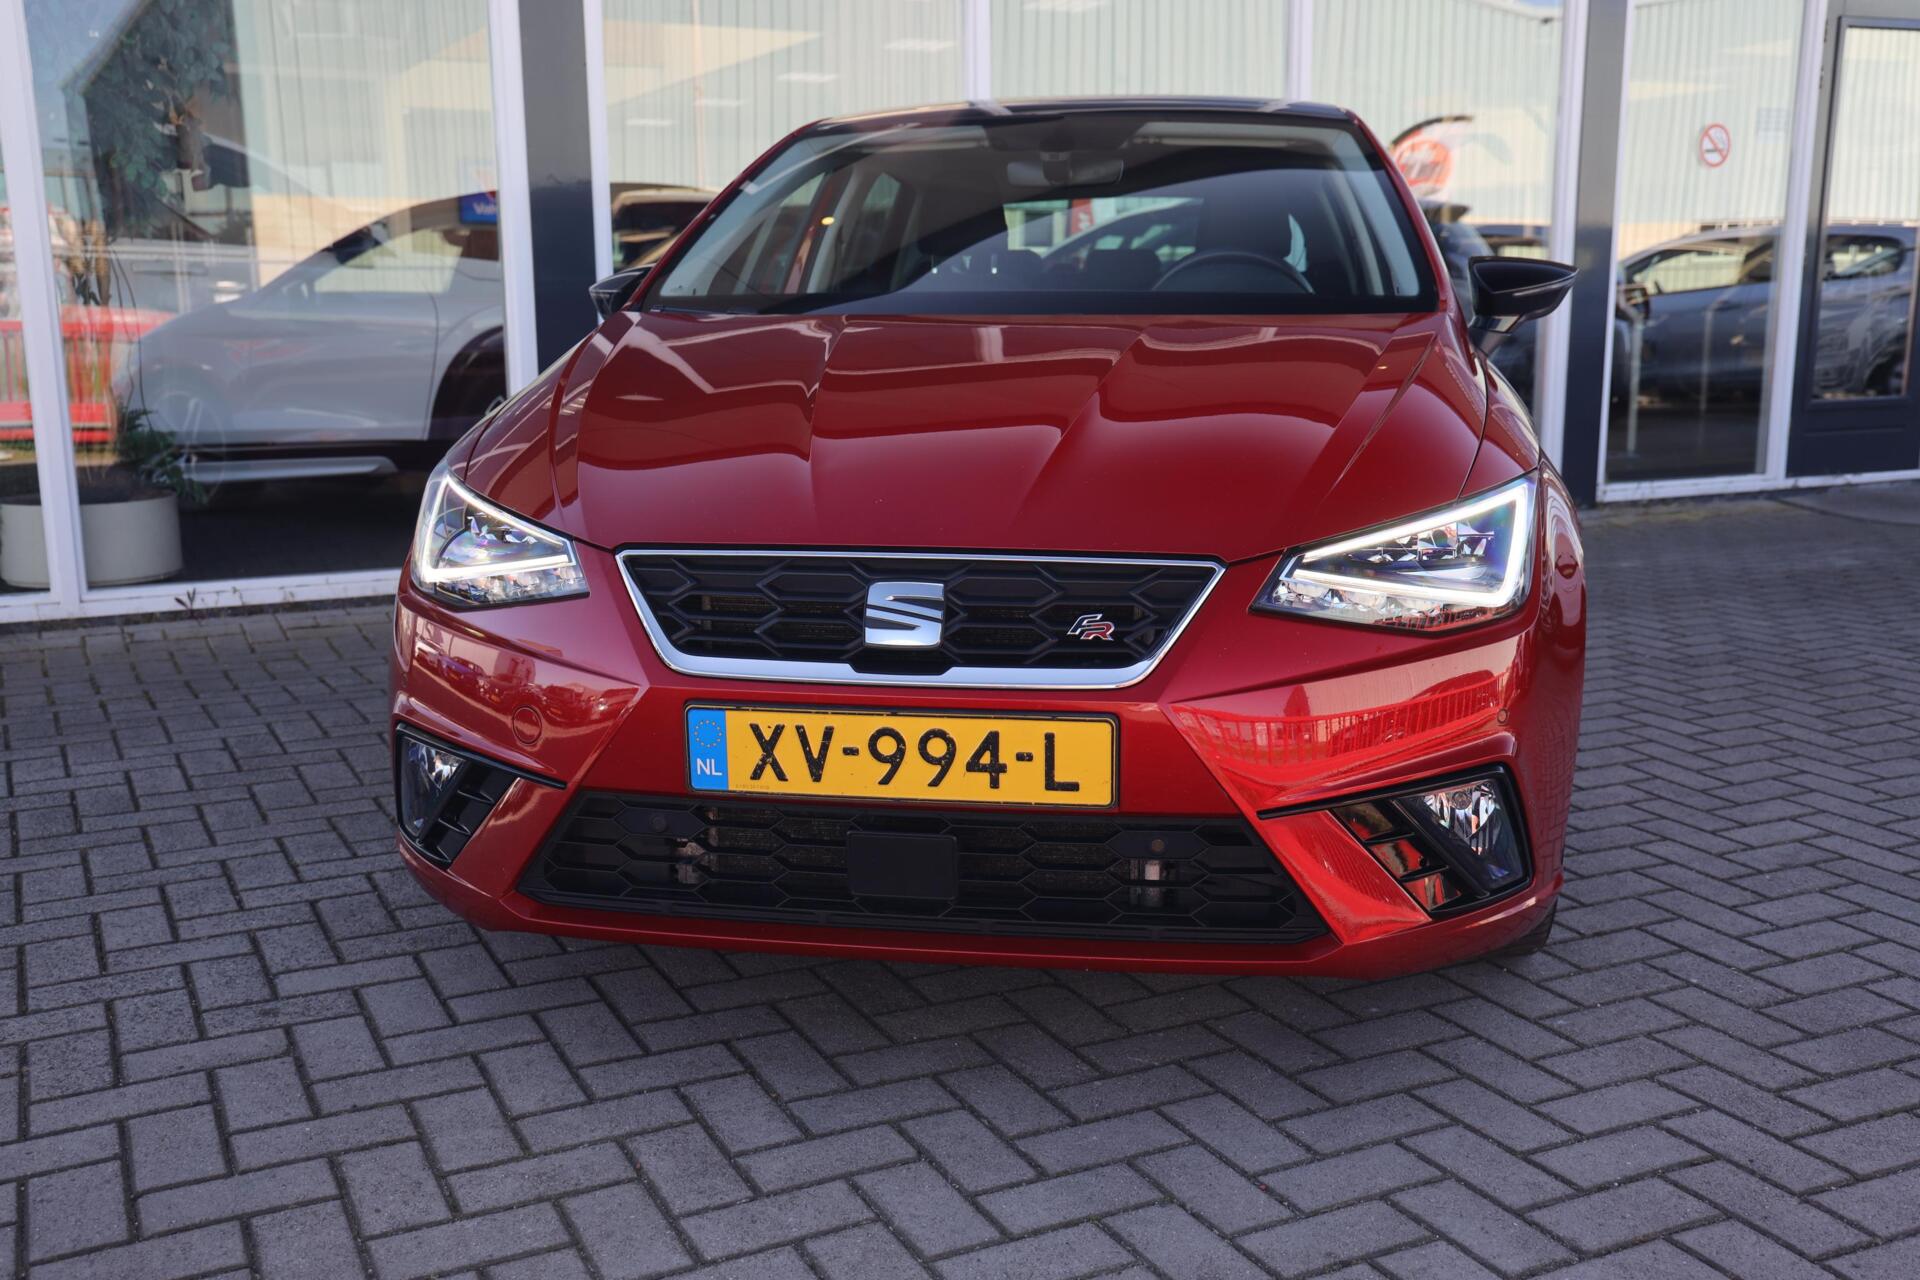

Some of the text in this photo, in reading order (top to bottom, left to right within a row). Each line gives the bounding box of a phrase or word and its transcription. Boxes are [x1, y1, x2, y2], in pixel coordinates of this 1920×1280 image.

[1067, 613, 1114, 641] FR
[696, 758, 722, 777] NL
[749, 722, 1080, 792] XV-994-L
